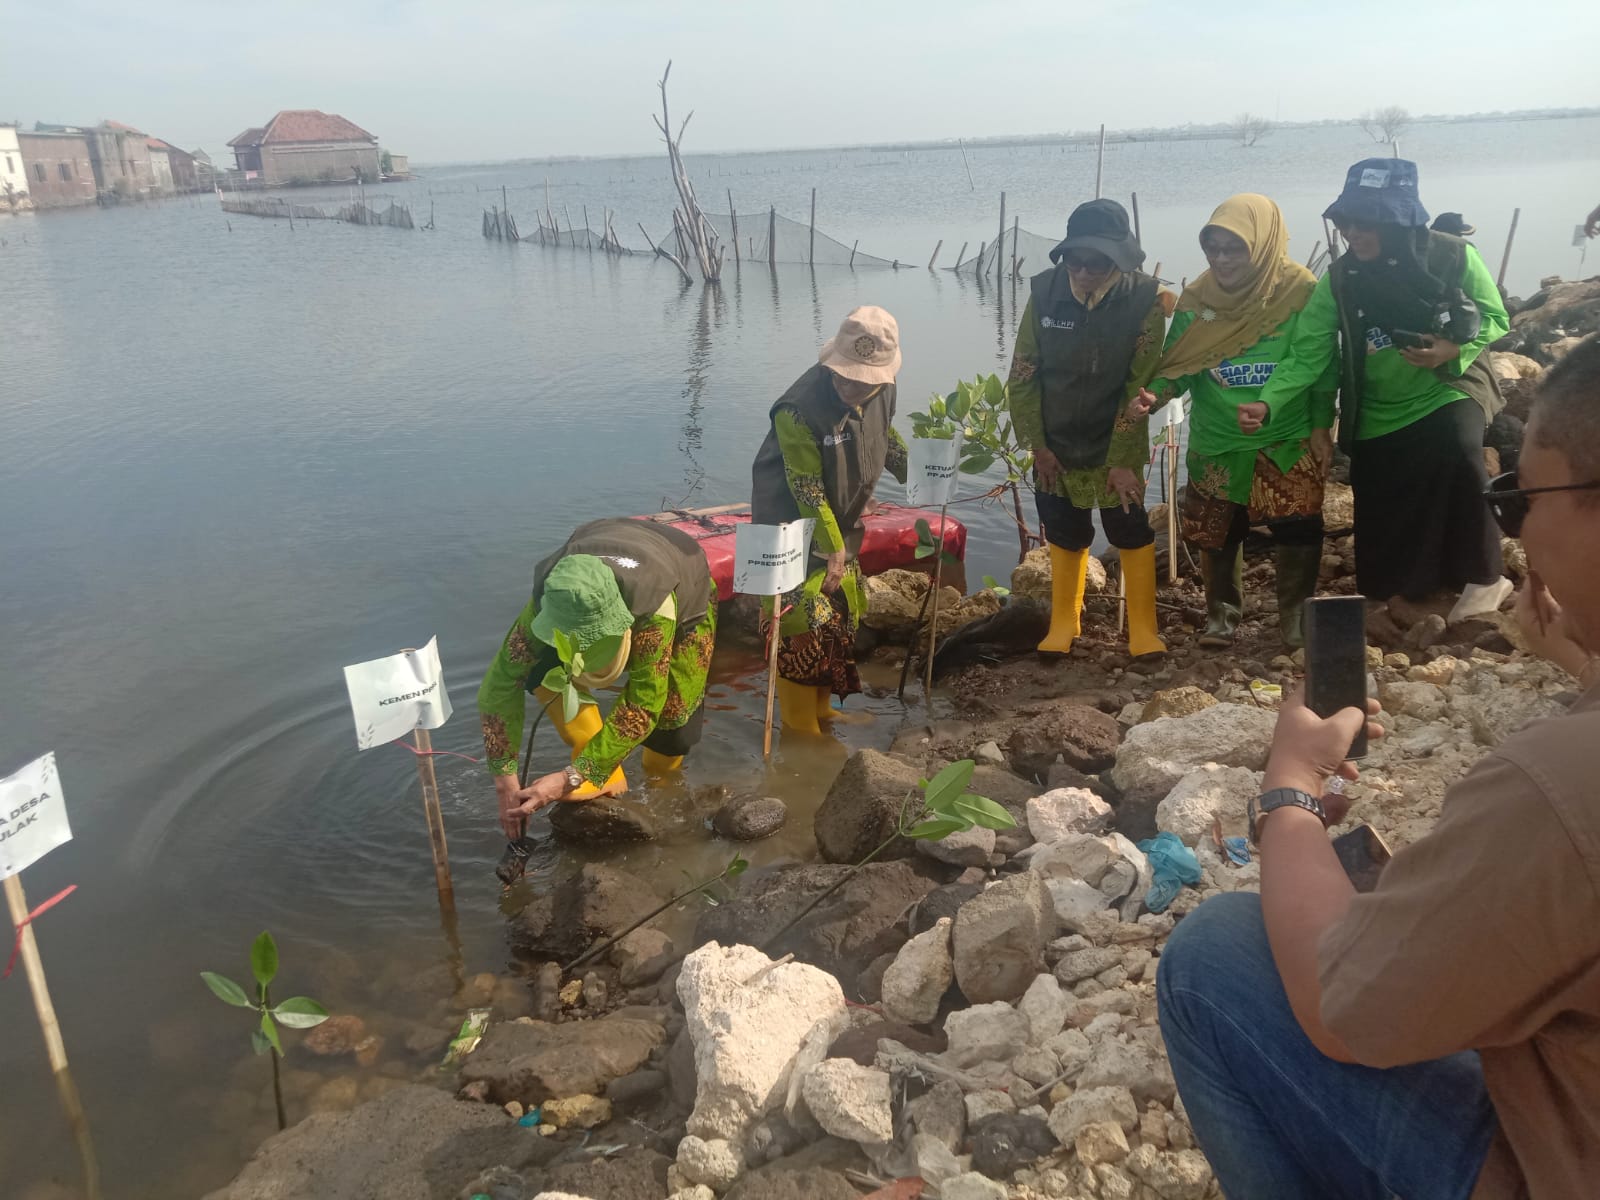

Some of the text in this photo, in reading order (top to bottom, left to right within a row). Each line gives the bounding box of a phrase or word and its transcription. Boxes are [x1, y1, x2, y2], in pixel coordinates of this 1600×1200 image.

[1220, 364, 1277, 379] SIAP UN
[379, 691, 421, 706] KEMEN
[10, 792, 50, 820] DESA
